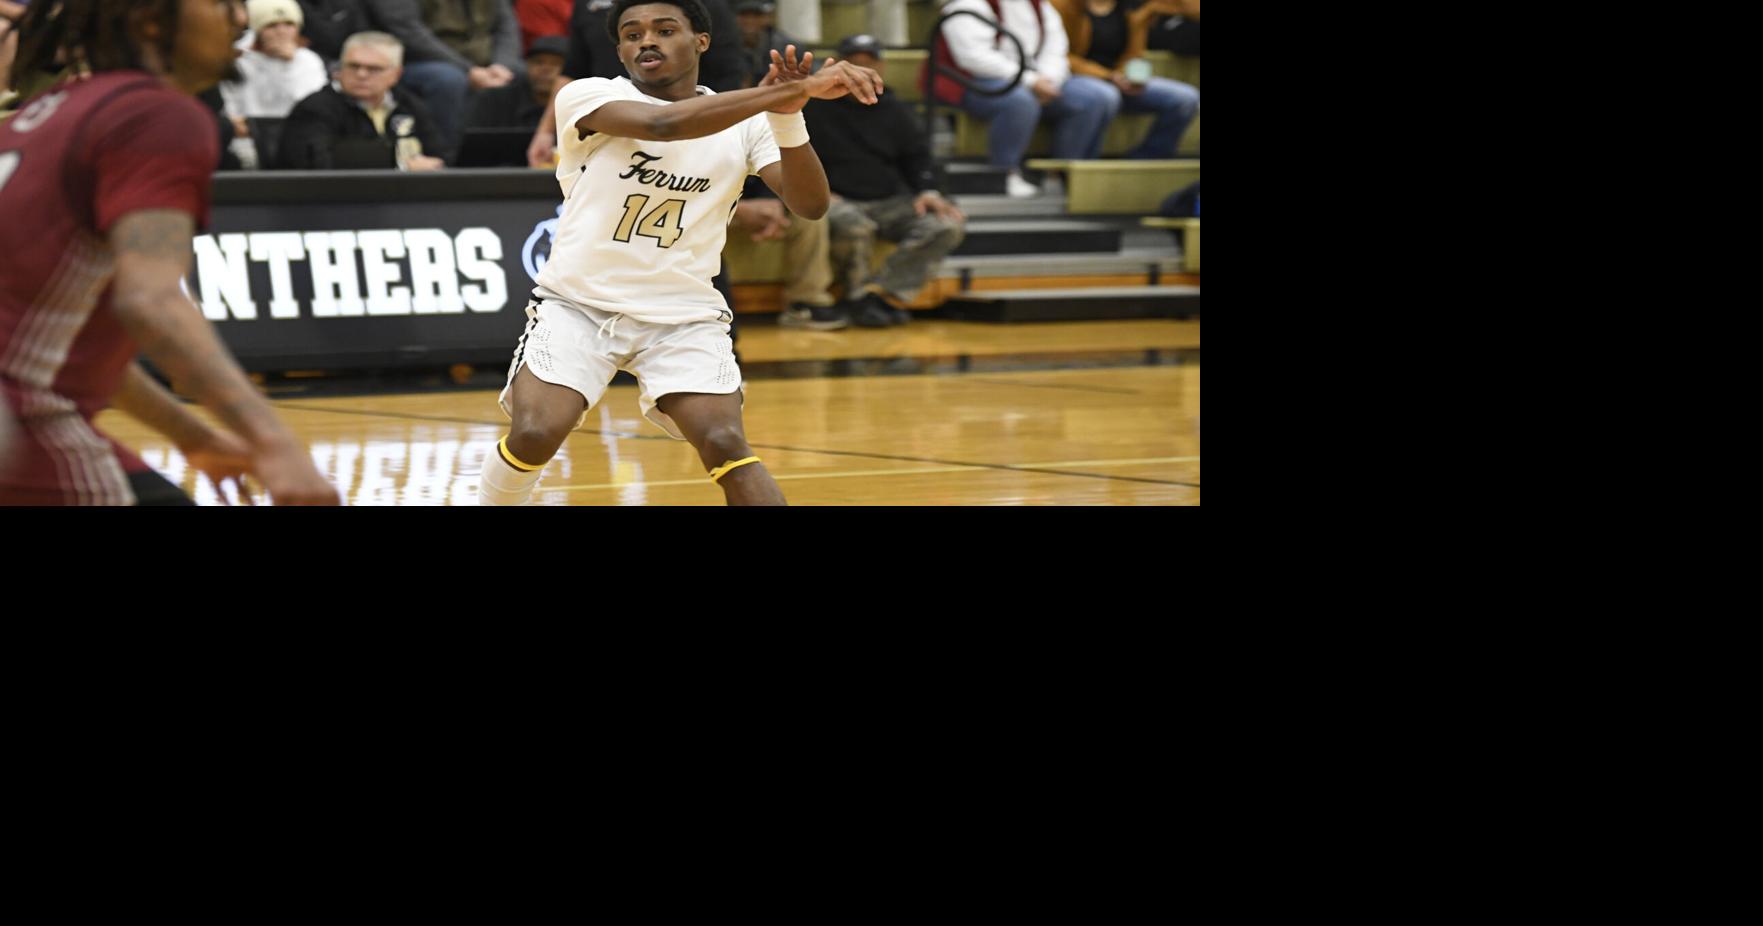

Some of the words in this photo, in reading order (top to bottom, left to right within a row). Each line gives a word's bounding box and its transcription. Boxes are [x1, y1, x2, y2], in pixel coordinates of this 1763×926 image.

[619, 150, 711, 193] Ferrum
[613, 193, 686, 249] 14
[181, 227, 508, 320] NTHERS
